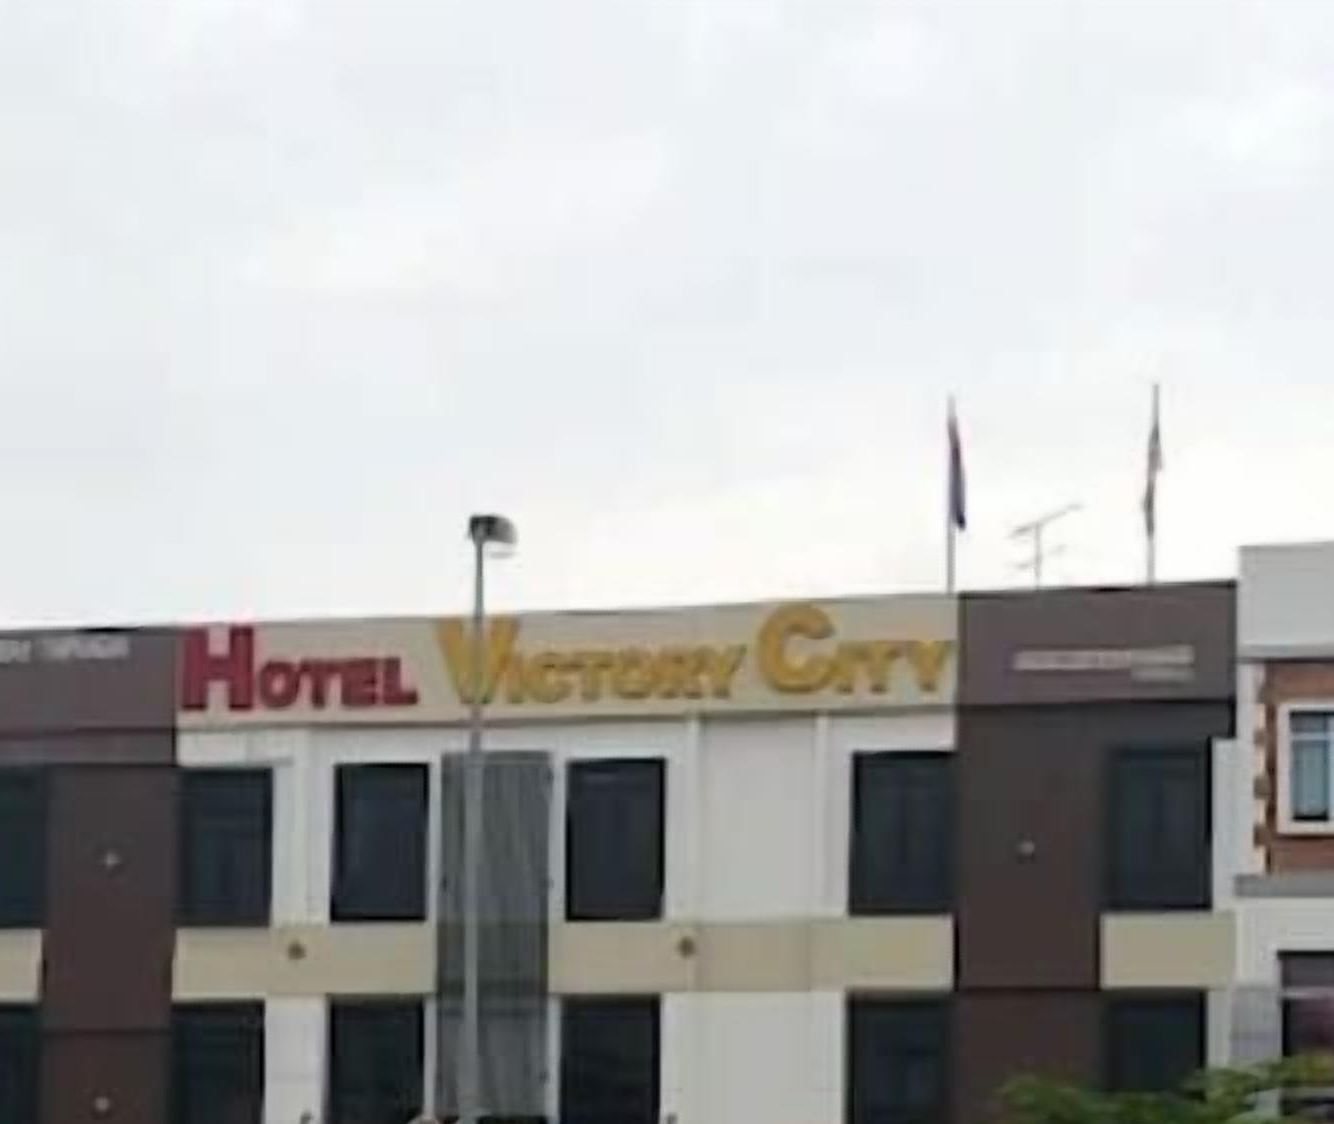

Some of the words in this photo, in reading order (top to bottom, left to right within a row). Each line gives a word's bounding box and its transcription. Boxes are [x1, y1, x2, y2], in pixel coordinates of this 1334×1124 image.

[180, 624, 419, 711] HOTEL
[433, 614, 748, 704] VICTORY
[757, 602, 957, 694] CITY
